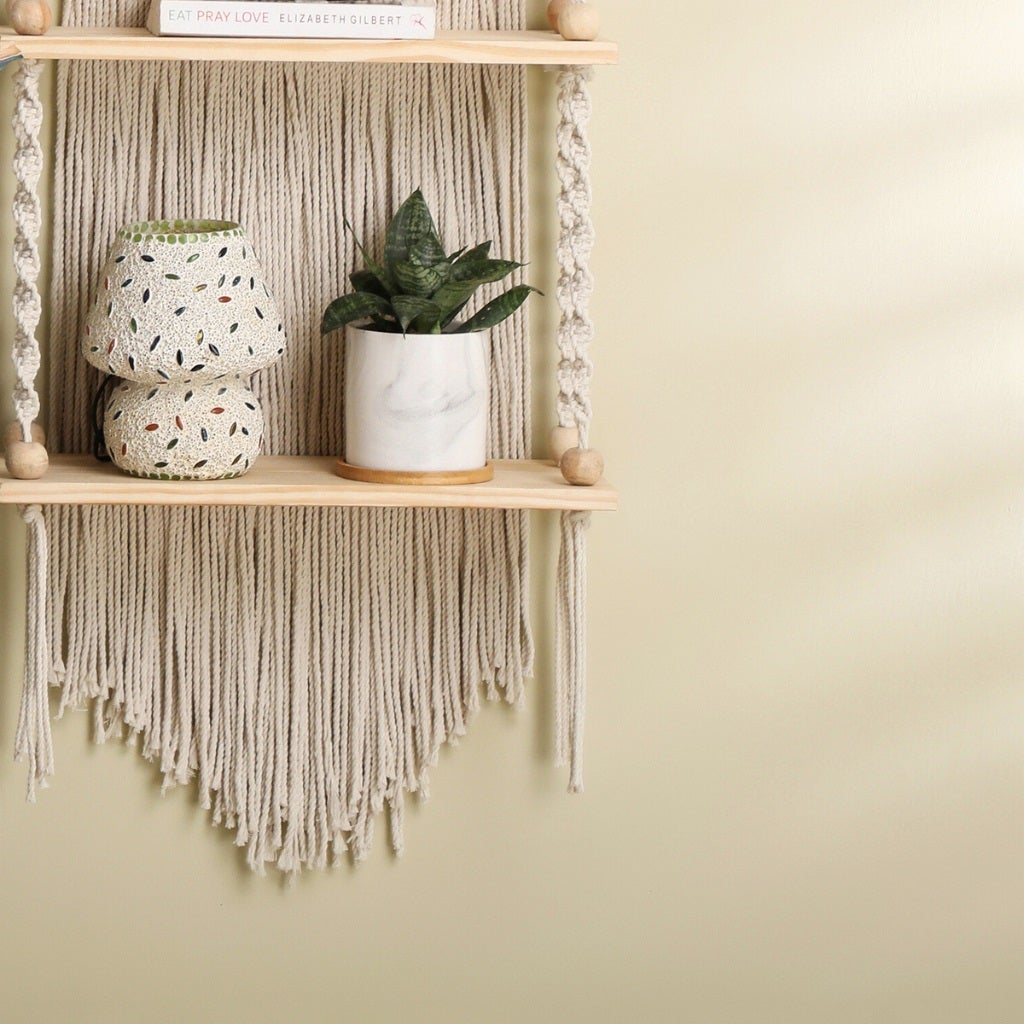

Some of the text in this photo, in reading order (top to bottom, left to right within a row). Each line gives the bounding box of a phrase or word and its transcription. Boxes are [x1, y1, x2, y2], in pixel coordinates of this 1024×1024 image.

[168, 10, 401, 25] EAT PRAY LOVE ELIZABETH GILBERT
